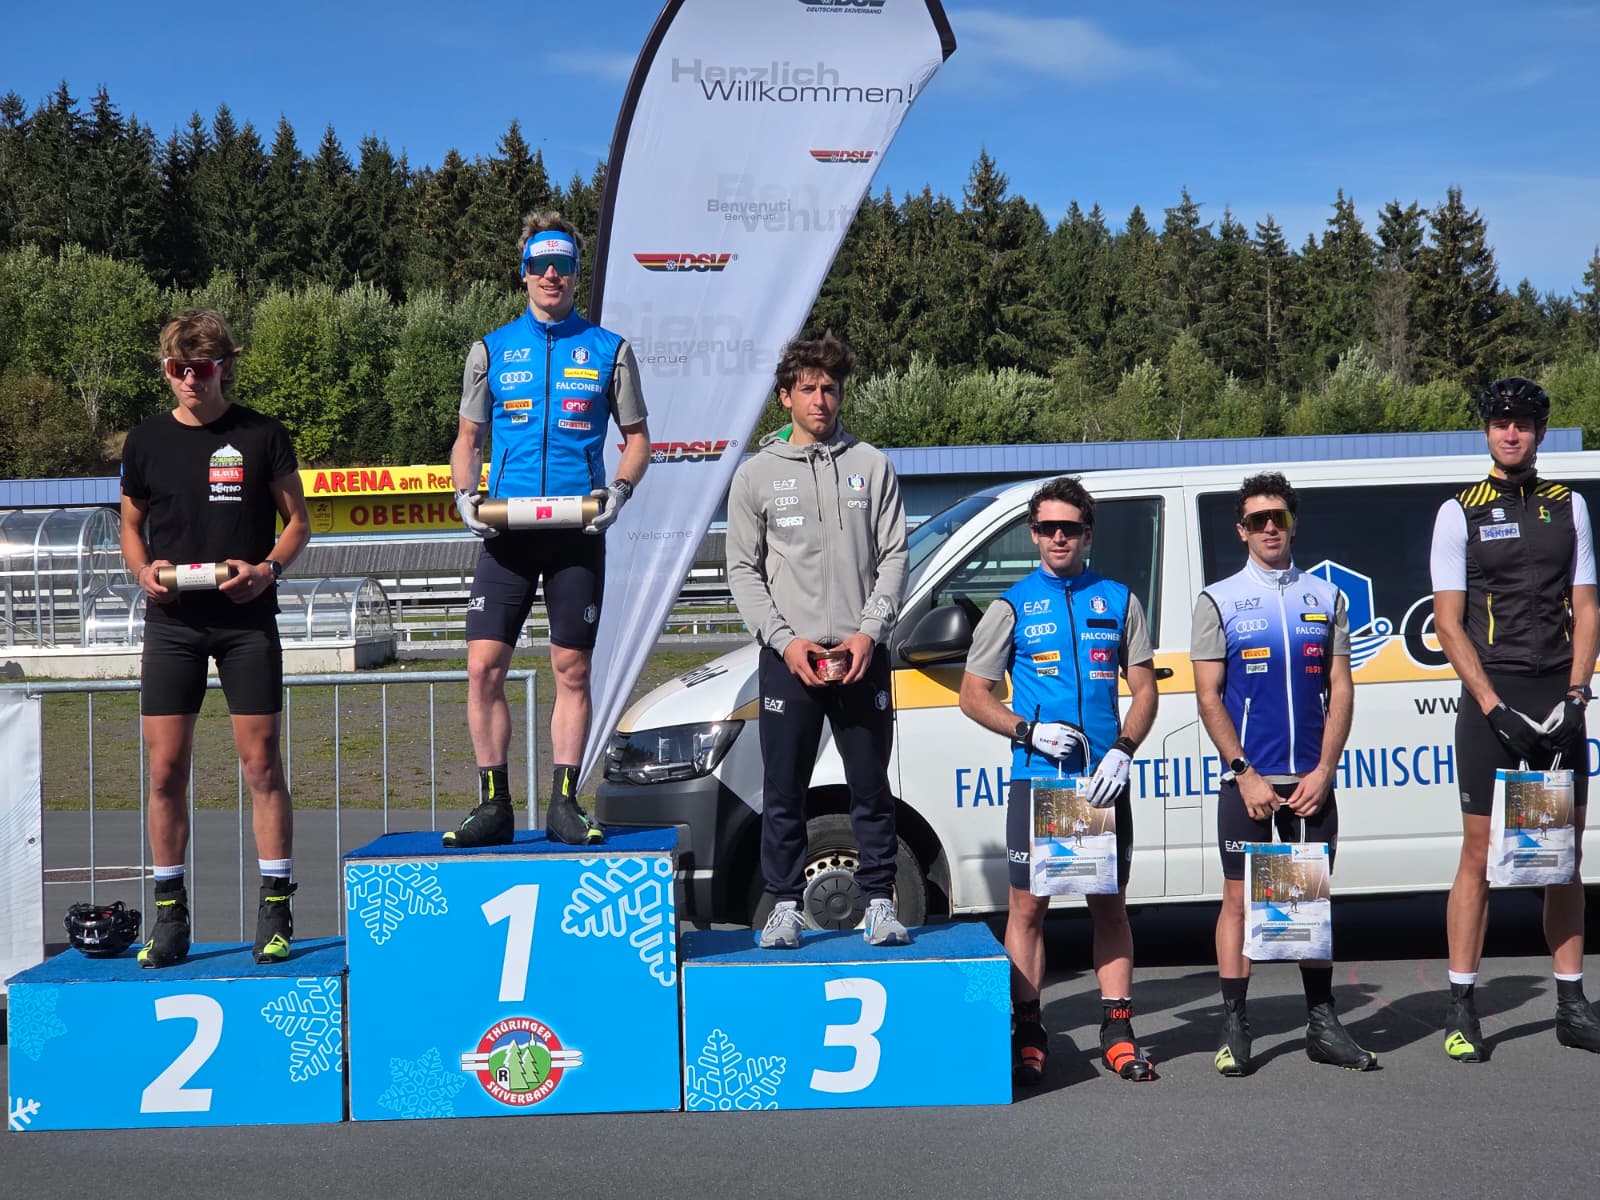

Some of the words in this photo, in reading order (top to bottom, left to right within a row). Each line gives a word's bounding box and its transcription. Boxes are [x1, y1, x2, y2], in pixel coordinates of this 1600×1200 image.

[671, 58, 840, 86] Herzlich
[701, 79, 914, 104] Willkommen!
[707, 199, 791, 215] Benvenuti
[724, 212, 777, 221] Benvenuti
[503, 347, 531, 361] EA7
[638, 354, 688, 364] venue
[556, 382, 602, 393] FALCONERI
[313, 469, 395, 493] ARENA
[399, 477, 421, 490] am
[773, 479, 797, 489] EA7
[350, 502, 464, 526] OBERHO
[627, 528, 695, 542] Welcome
[1023, 599, 1051, 613] EA7
[1234, 598, 1261, 610] EA7
[764, 697, 784, 710] EA7
[1225, 840, 1246, 851] EA7
[1009, 849, 1029, 862] EA7
[481, 884, 540, 1002] 1
[485, 1019, 552, 1043] THÜRINGER
[809, 977, 888, 1094] 3
[139, 993, 224, 1113] 2
[498, 1070, 509, 1082] R
[486, 1079, 554, 1105] SKIVERBAND
